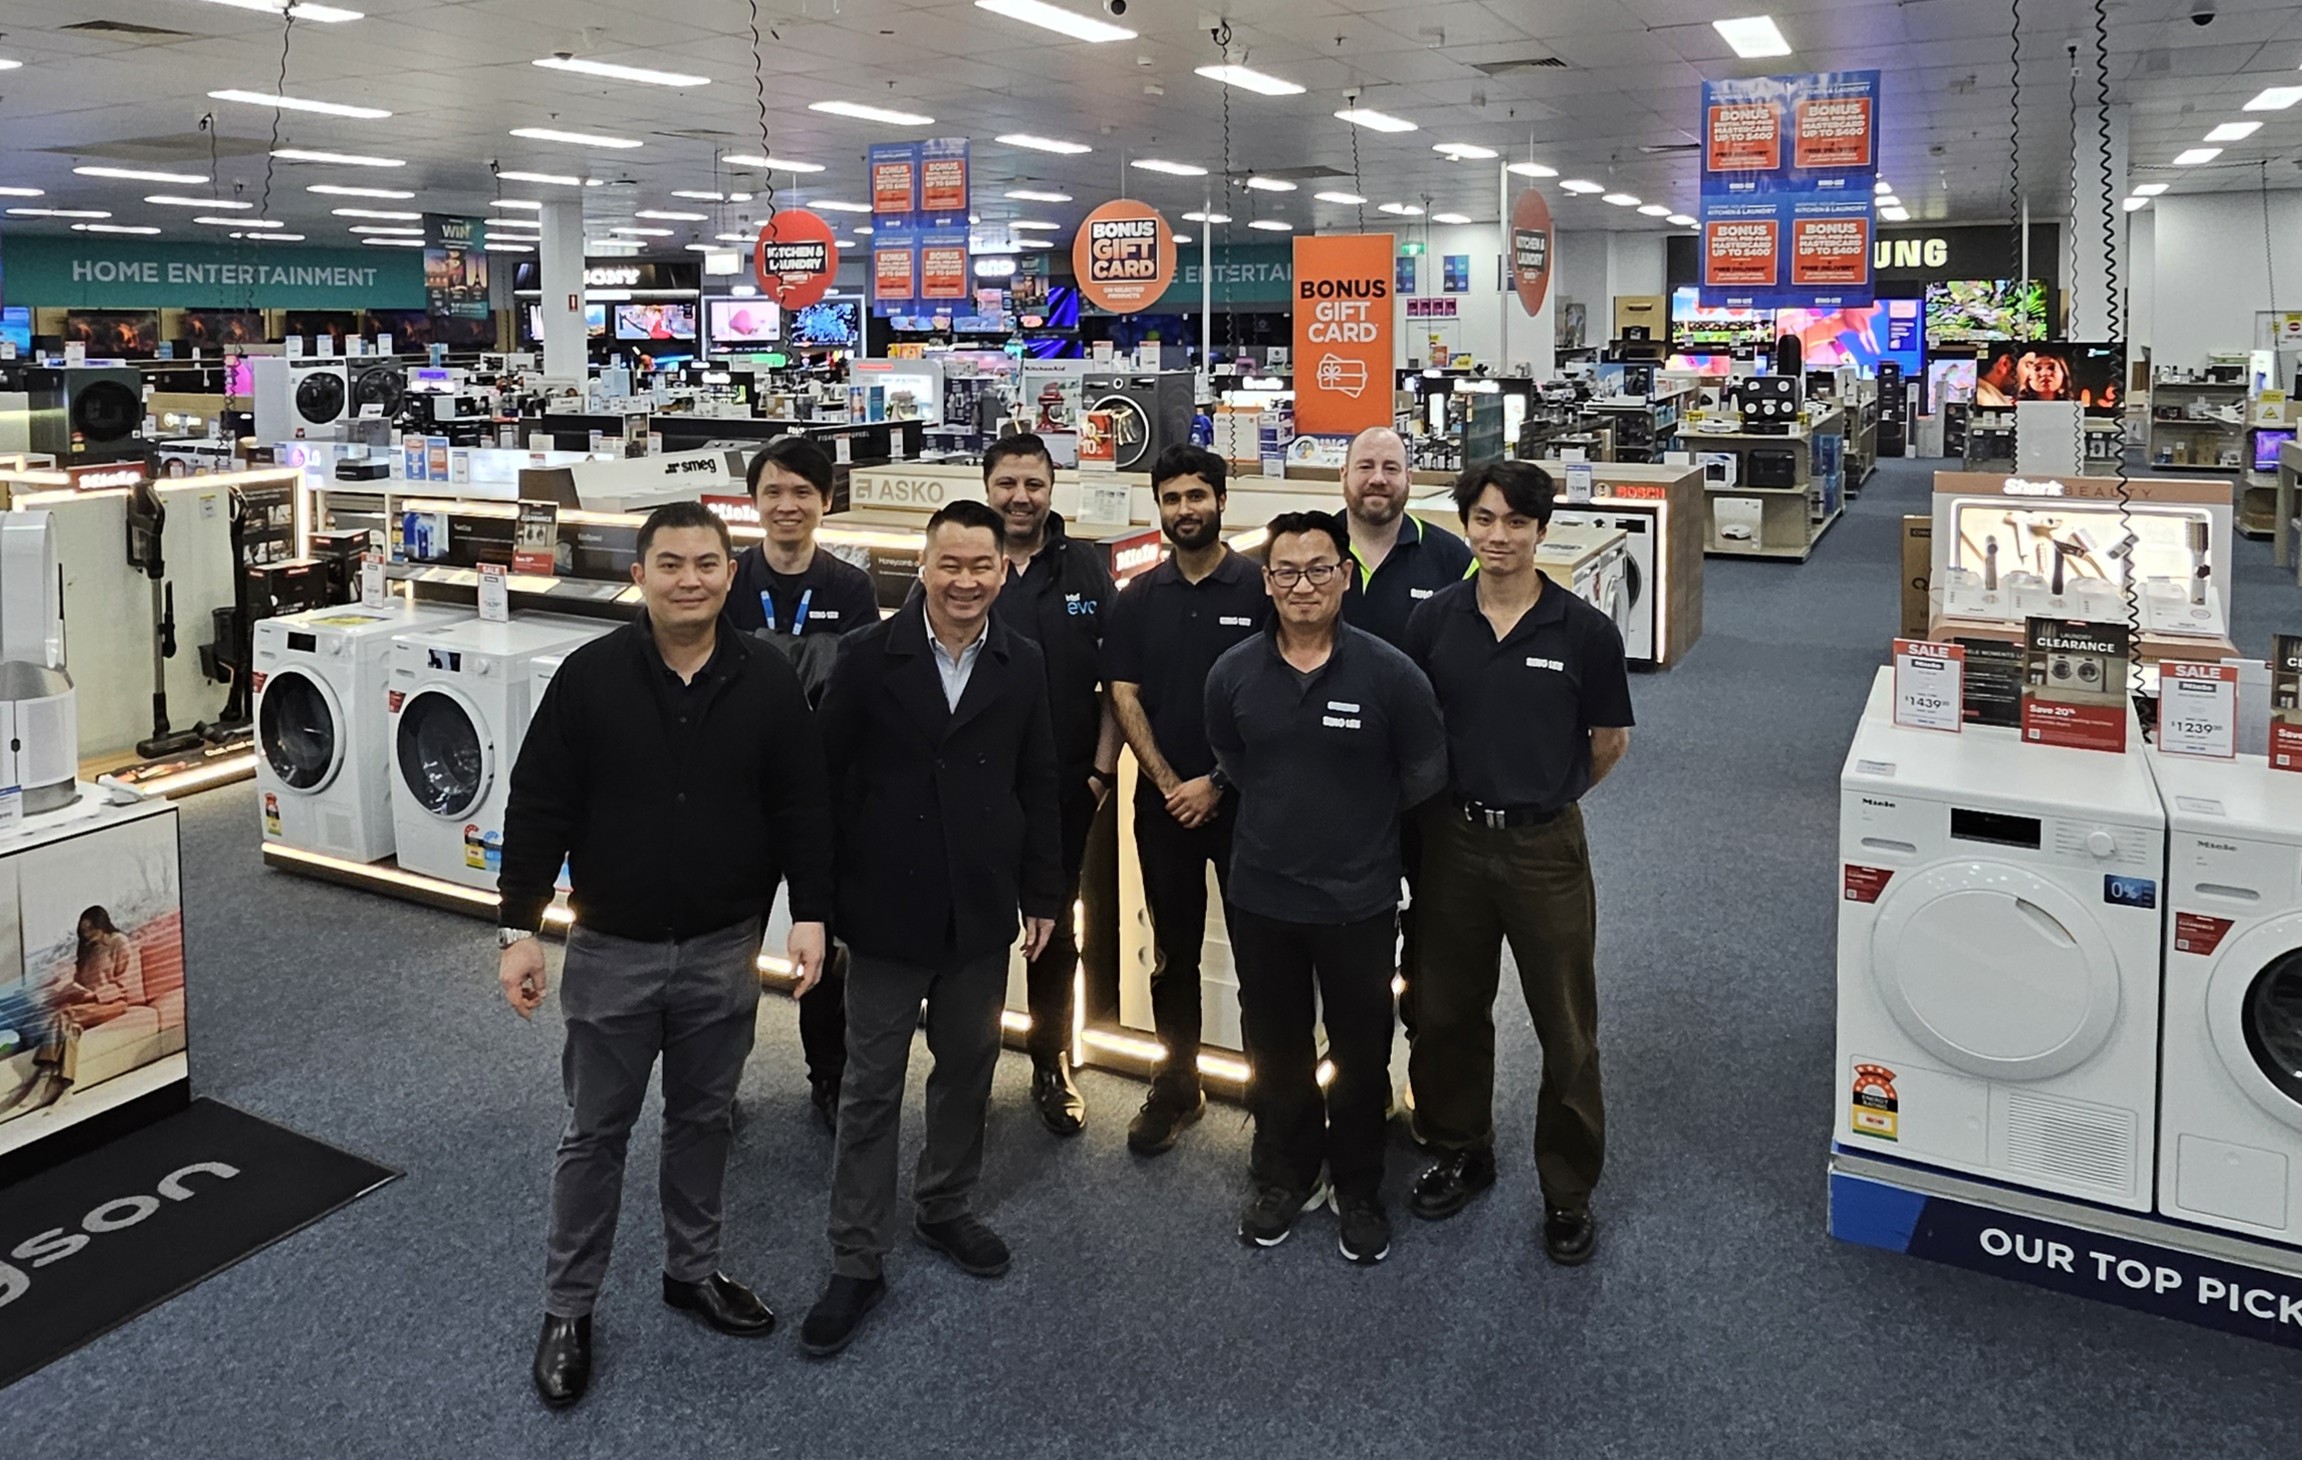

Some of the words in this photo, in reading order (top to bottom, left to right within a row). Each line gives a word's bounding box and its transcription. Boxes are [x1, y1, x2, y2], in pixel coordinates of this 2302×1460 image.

[1720, 109, 1769, 121] BONUS
[1808, 104, 1861, 116] BONUS
[1714, 134, 1729, 142] UP
[1802, 130, 1817, 138] UP
[442, 224, 472, 239] WIN
[1093, 222, 1154, 238] BONUS
[1718, 226, 1767, 236] BONUS
[1806, 223, 1857, 234] BONUS
[815, 246, 824, 257] &
[1093, 237, 1154, 259] GIFT
[1712, 249, 1727, 257] UP
[1800, 247, 1814, 255] UP
[1816, 247, 1830, 255] TO
[1874, 239, 1948, 269] UNG
[769, 258, 821, 270] LAUNDRY
[1093, 260, 1155, 278] CARD
[72, 260, 160, 282] HOME
[168, 263, 377, 286] ENTERTAINMENT
[1300, 279, 1386, 299] BONUS
[1316, 302, 1371, 322] GIFT
[1308, 323, 1377, 342] CARD
[306, 448, 322, 466] LG
[681, 458, 716, 473] smeg
[78, 471, 141, 490] Miele
[2003, 478, 2064, 496] Shark
[2064, 486, 2153, 498] BEAUTY
[878, 480, 944, 502] ASKO
[1616, 486, 1665, 499] BOSCH
[878, 556, 914, 566] Honeycomb
[1116, 544, 1159, 572] Miele
[1908, 644, 1949, 658] SALE
[2037, 637, 2115, 653] CLEARANCE
[2175, 665, 2221, 679] SALE
[2029, 704, 2053, 715] Save
[2055, 707, 2076, 717] 20%
[1863, 798, 1896, 808] Miele
[2196, 840, 2237, 851] Miele
[2111, 882, 2137, 899] 0%
[0, 1162, 240, 1306] son
[1979, 1228, 2075, 1273] OUR
[2089, 1251, 2182, 1294] TOP
[2198, 1276, 2302, 1328] PICK
